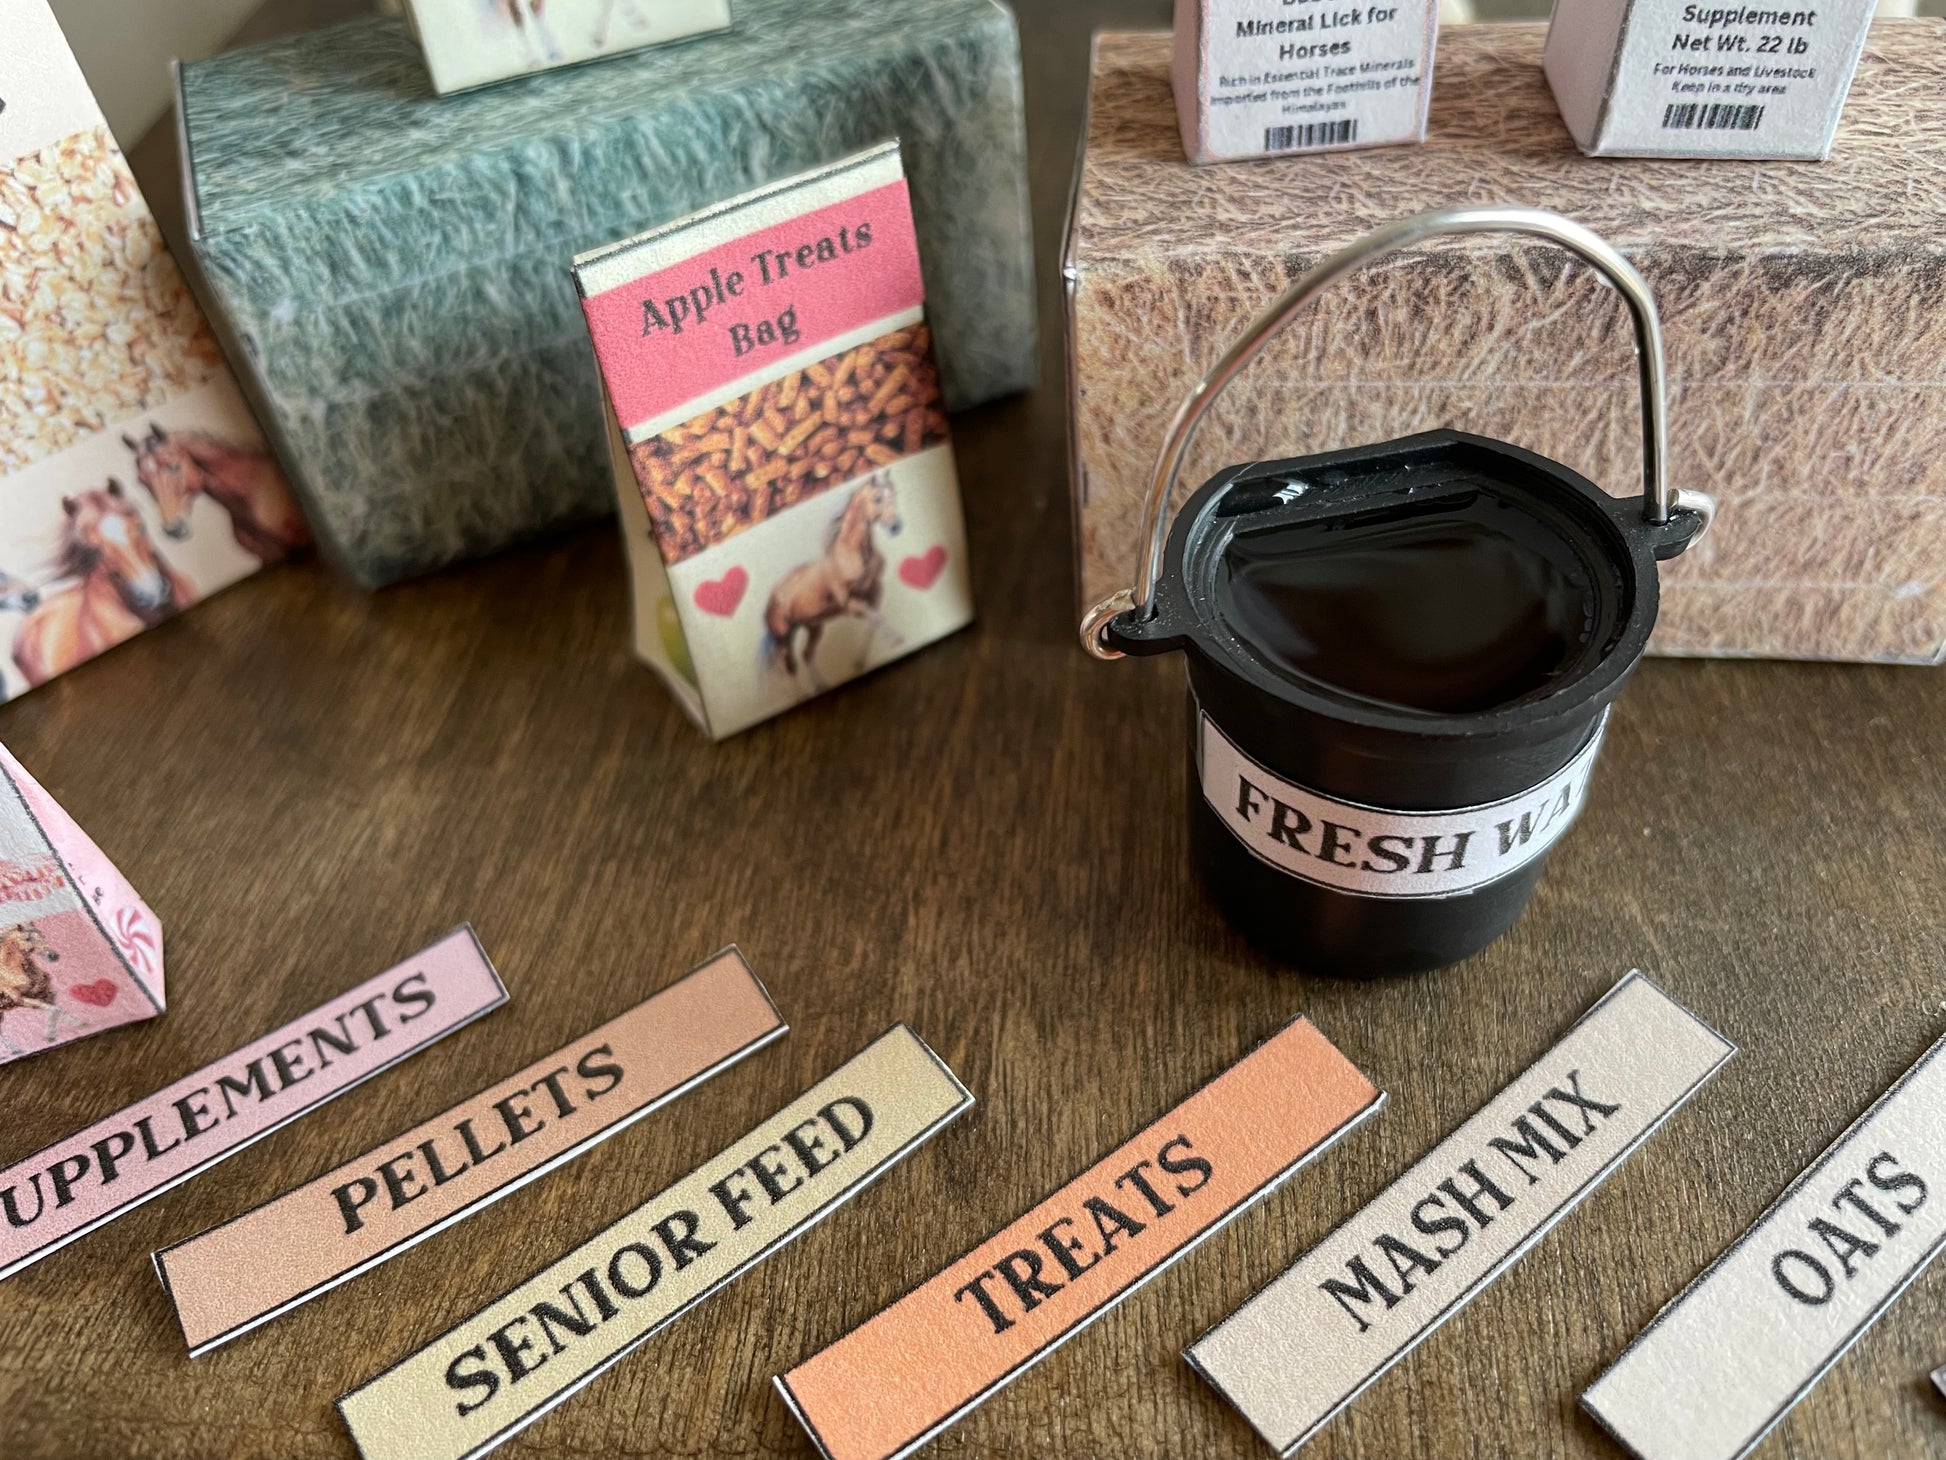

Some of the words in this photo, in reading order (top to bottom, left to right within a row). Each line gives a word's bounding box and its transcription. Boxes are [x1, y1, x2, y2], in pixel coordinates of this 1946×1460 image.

[1235, 14, 1314, 38] Mineral
[1320, 8, 1362, 30] Lick
[1366, 6, 1399, 25] for
[1682, 4, 1818, 29] Supplement
[1278, 40, 1352, 62] Horses
[1671, 33, 1714, 52] Net
[1716, 34, 1750, 53] Wt.
[1756, 35, 1784, 54] 22
[1786, 36, 1810, 55] lb
[1219, 73, 1247, 88] Rich
[1250, 72, 1262, 86] in
[1262, 67, 1320, 85] Essential
[1323, 64, 1356, 79] Trace
[1359, 58, 1415, 74] Minerals
[1269, 88, 1300, 102] from
[1303, 83, 1324, 97] the
[1326, 79, 1382, 96] Foothills
[1384, 77, 1398, 90] of
[1400, 75, 1421, 88] the
[1653, 62, 1677, 76] For
[1677, 63, 1723, 77] Horses
[1726, 64, 1751, 78] and
[1752, 65, 1817, 79] Livestock
[1671, 80, 1705, 95] Keep
[1707, 81, 1721, 93] in
[1733, 82, 1756, 97] dry
[1757, 85, 1787, 95] area
[641, 267, 745, 338] Apple
[750, 222, 874, 286] Treats
[727, 303, 802, 358] Bag
[1233, 773, 1477, 875] FRESH
[331, 1043, 625, 1236] PELLETS
[1317, 1158, 1517, 1334] MASH
[1486, 1068, 1624, 1186] MIX
[953, 1133, 1214, 1335] TREATS
[1770, 1149, 1930, 1307] OATS
[443, 1209, 718, 1418] SENIOR
[708, 1094, 876, 1232] FEED
